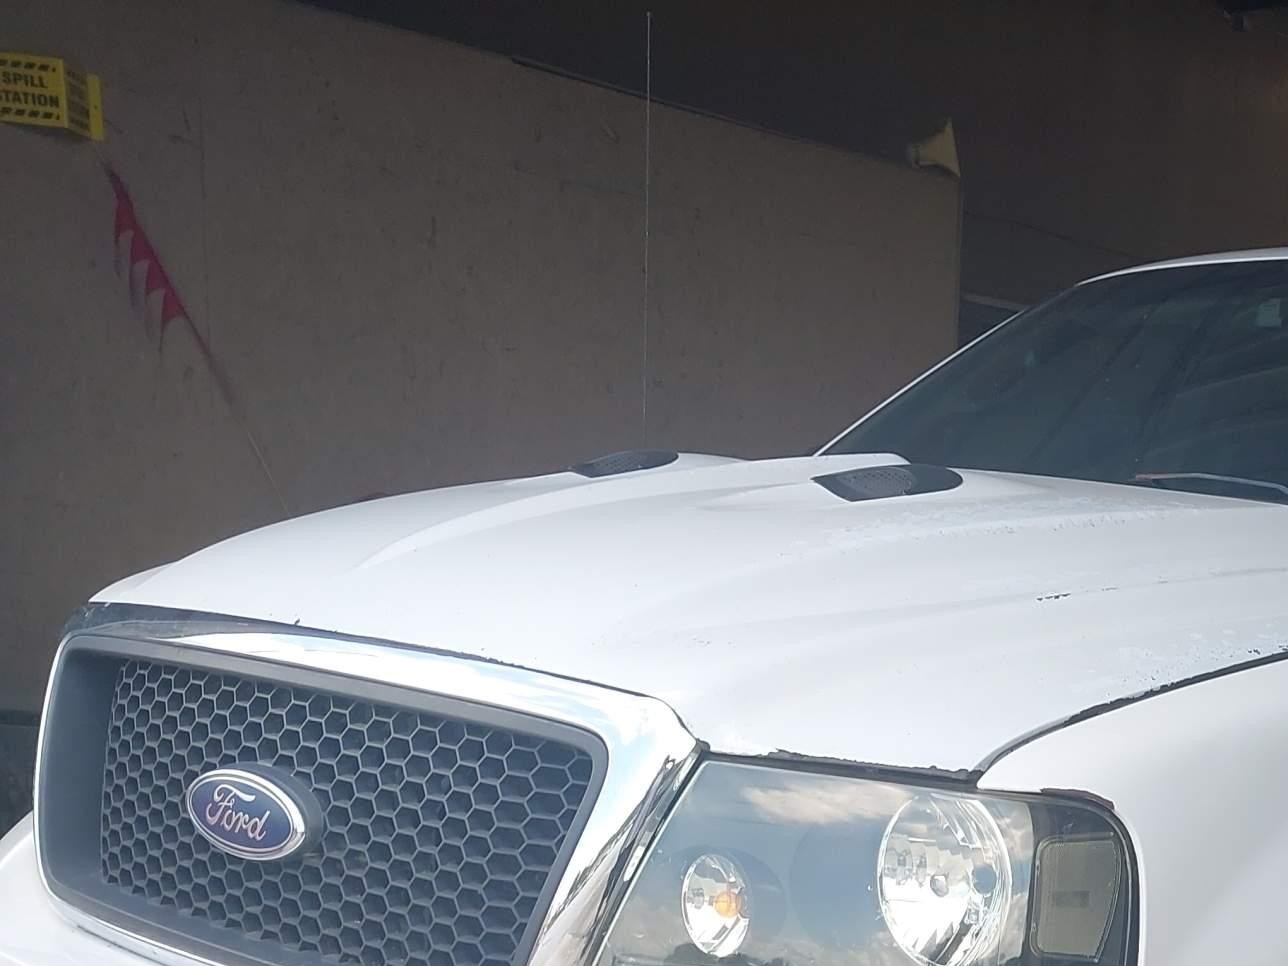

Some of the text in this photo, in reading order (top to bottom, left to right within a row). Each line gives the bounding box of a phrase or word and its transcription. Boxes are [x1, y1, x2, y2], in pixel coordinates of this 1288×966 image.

[2, 71, 48, 88] SPILL
[0, 90, 60, 108] TATION
[205, 783, 271, 841] Ford
